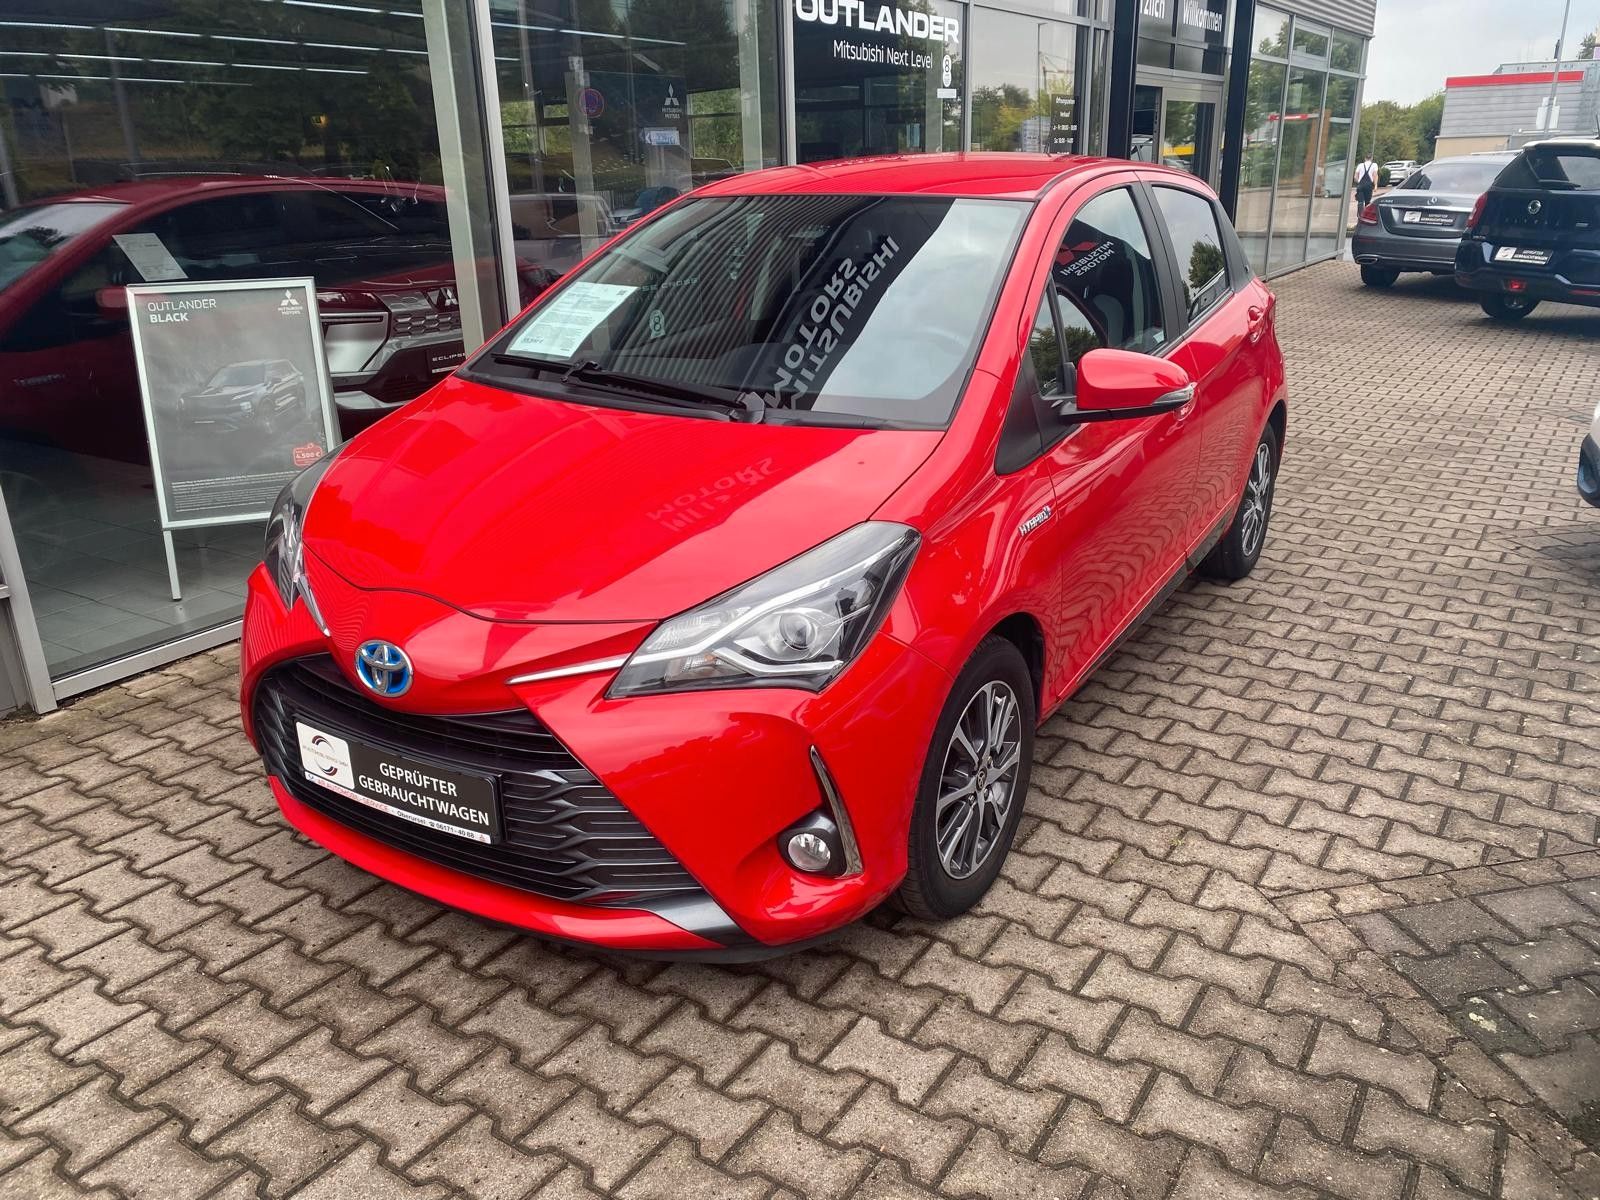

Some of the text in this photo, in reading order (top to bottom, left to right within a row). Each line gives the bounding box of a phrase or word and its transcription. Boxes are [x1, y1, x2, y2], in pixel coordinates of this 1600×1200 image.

[795, 0, 960, 44] OUTLANDER
[832, 39, 933, 70] Mitsubishi Next Level
[147, 299, 217, 312] OUTLANDER
[150, 312, 189, 324] BLACK
[432, 352, 466, 362] ECLIPS
[380, 762, 458, 797] GEPRÜFTER
[358, 774, 490, 826] GEBRAUCHTWAGEN
